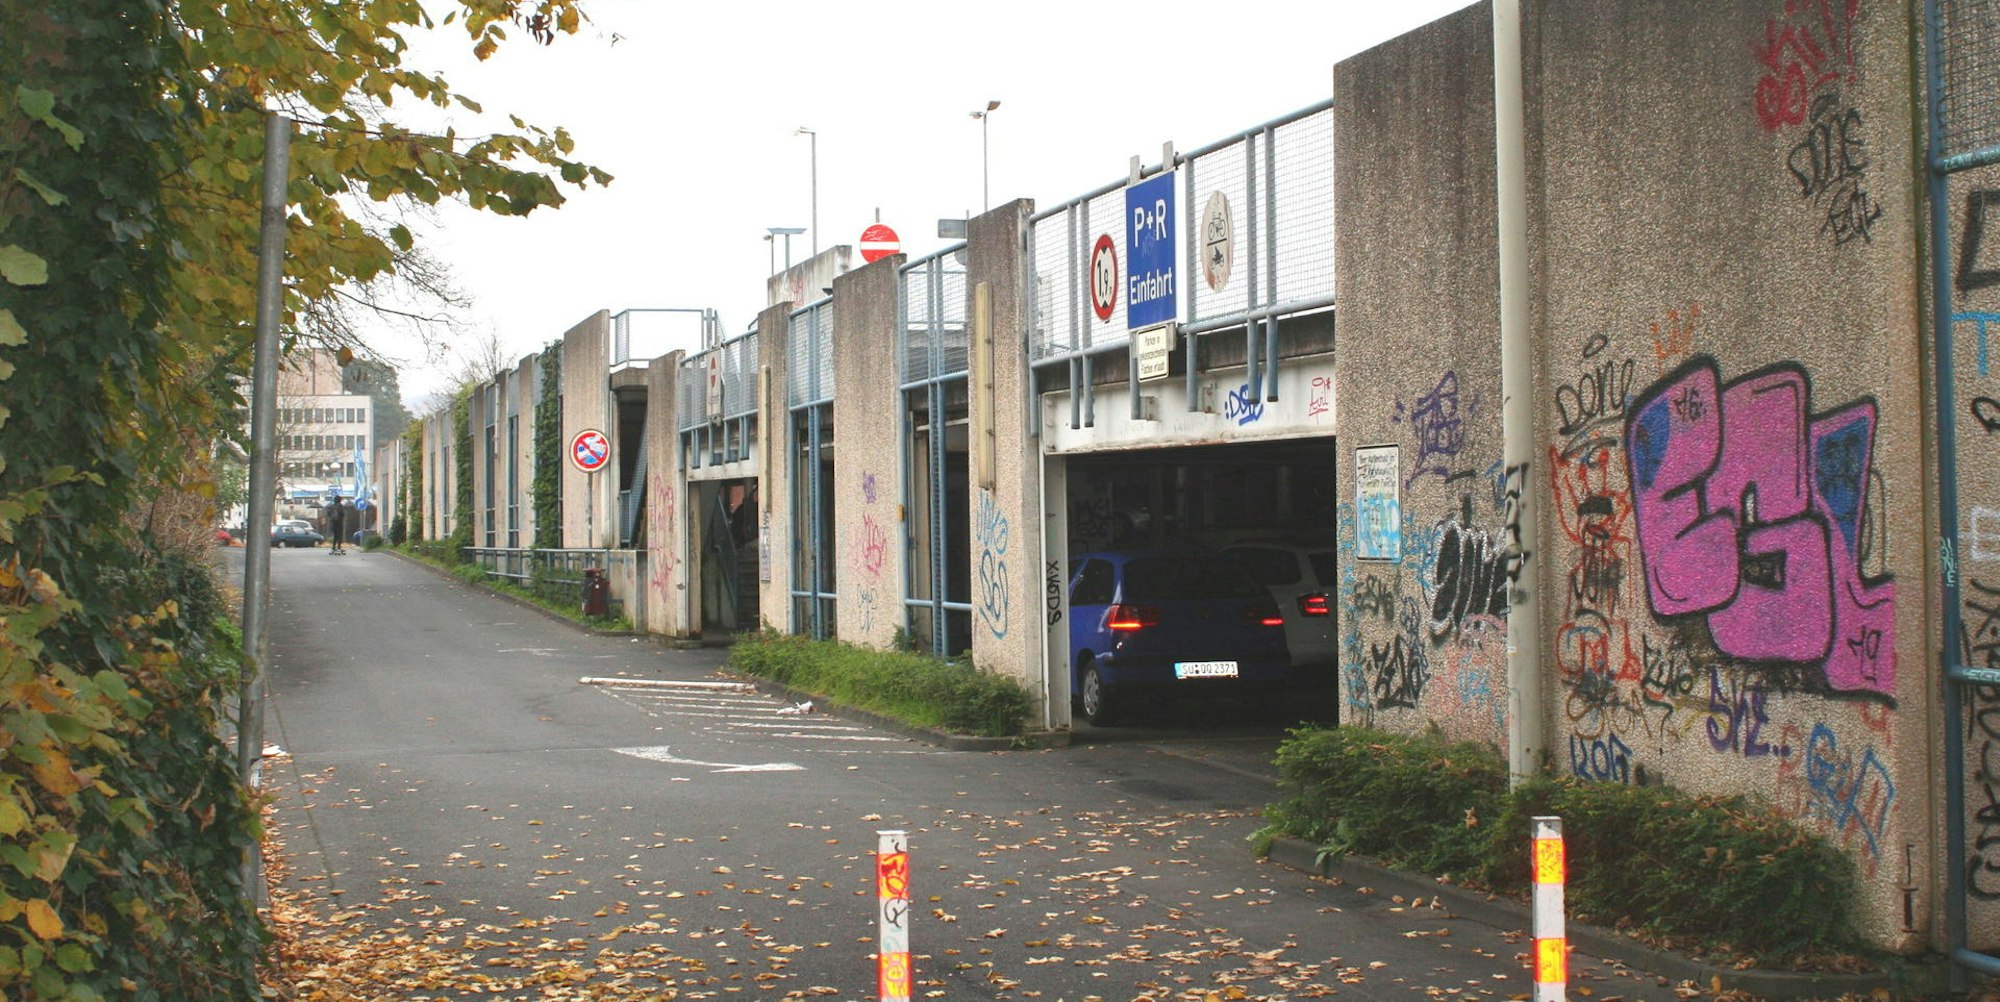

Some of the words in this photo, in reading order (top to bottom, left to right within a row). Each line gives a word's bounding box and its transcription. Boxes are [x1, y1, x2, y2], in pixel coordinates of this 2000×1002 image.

[1134, 199, 1166, 248] P+R
[1130, 266, 1173, 306] Einfahrt
[1182, 664, 1194, 675] SU
[1214, 663, 1236, 674] 2371
